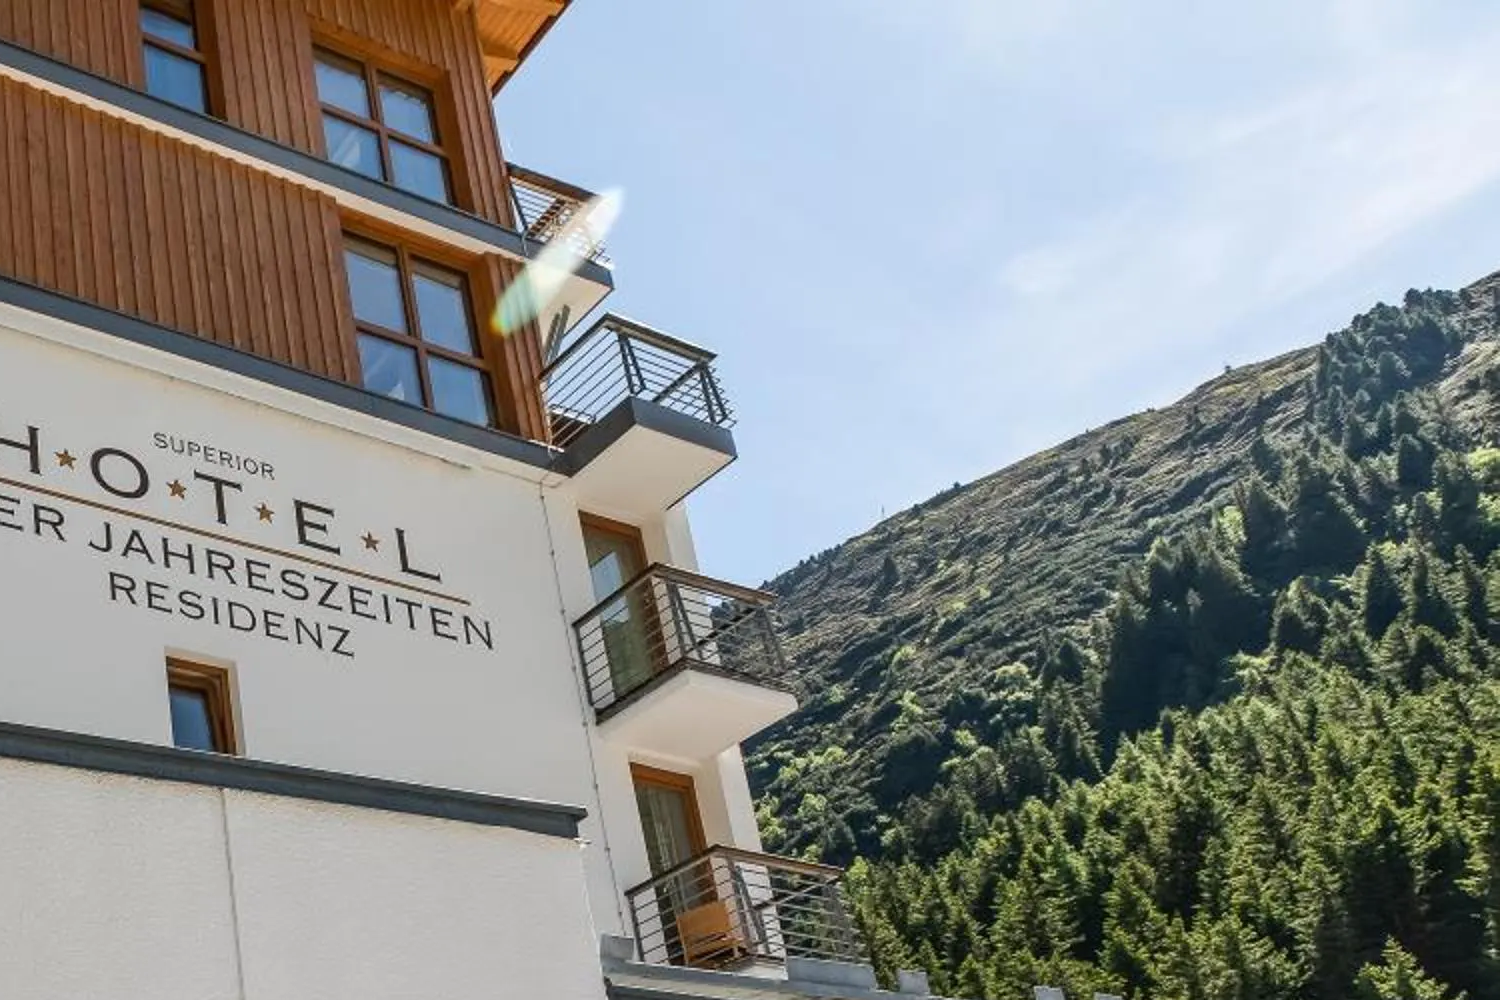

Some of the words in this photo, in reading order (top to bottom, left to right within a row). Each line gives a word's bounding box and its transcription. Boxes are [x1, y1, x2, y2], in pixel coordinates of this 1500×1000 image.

[152, 432, 276, 481] SUPERIOR
[87, 521, 494, 651] JAHRESZEITEN
[107, 571, 356, 659] RESIDENZ
